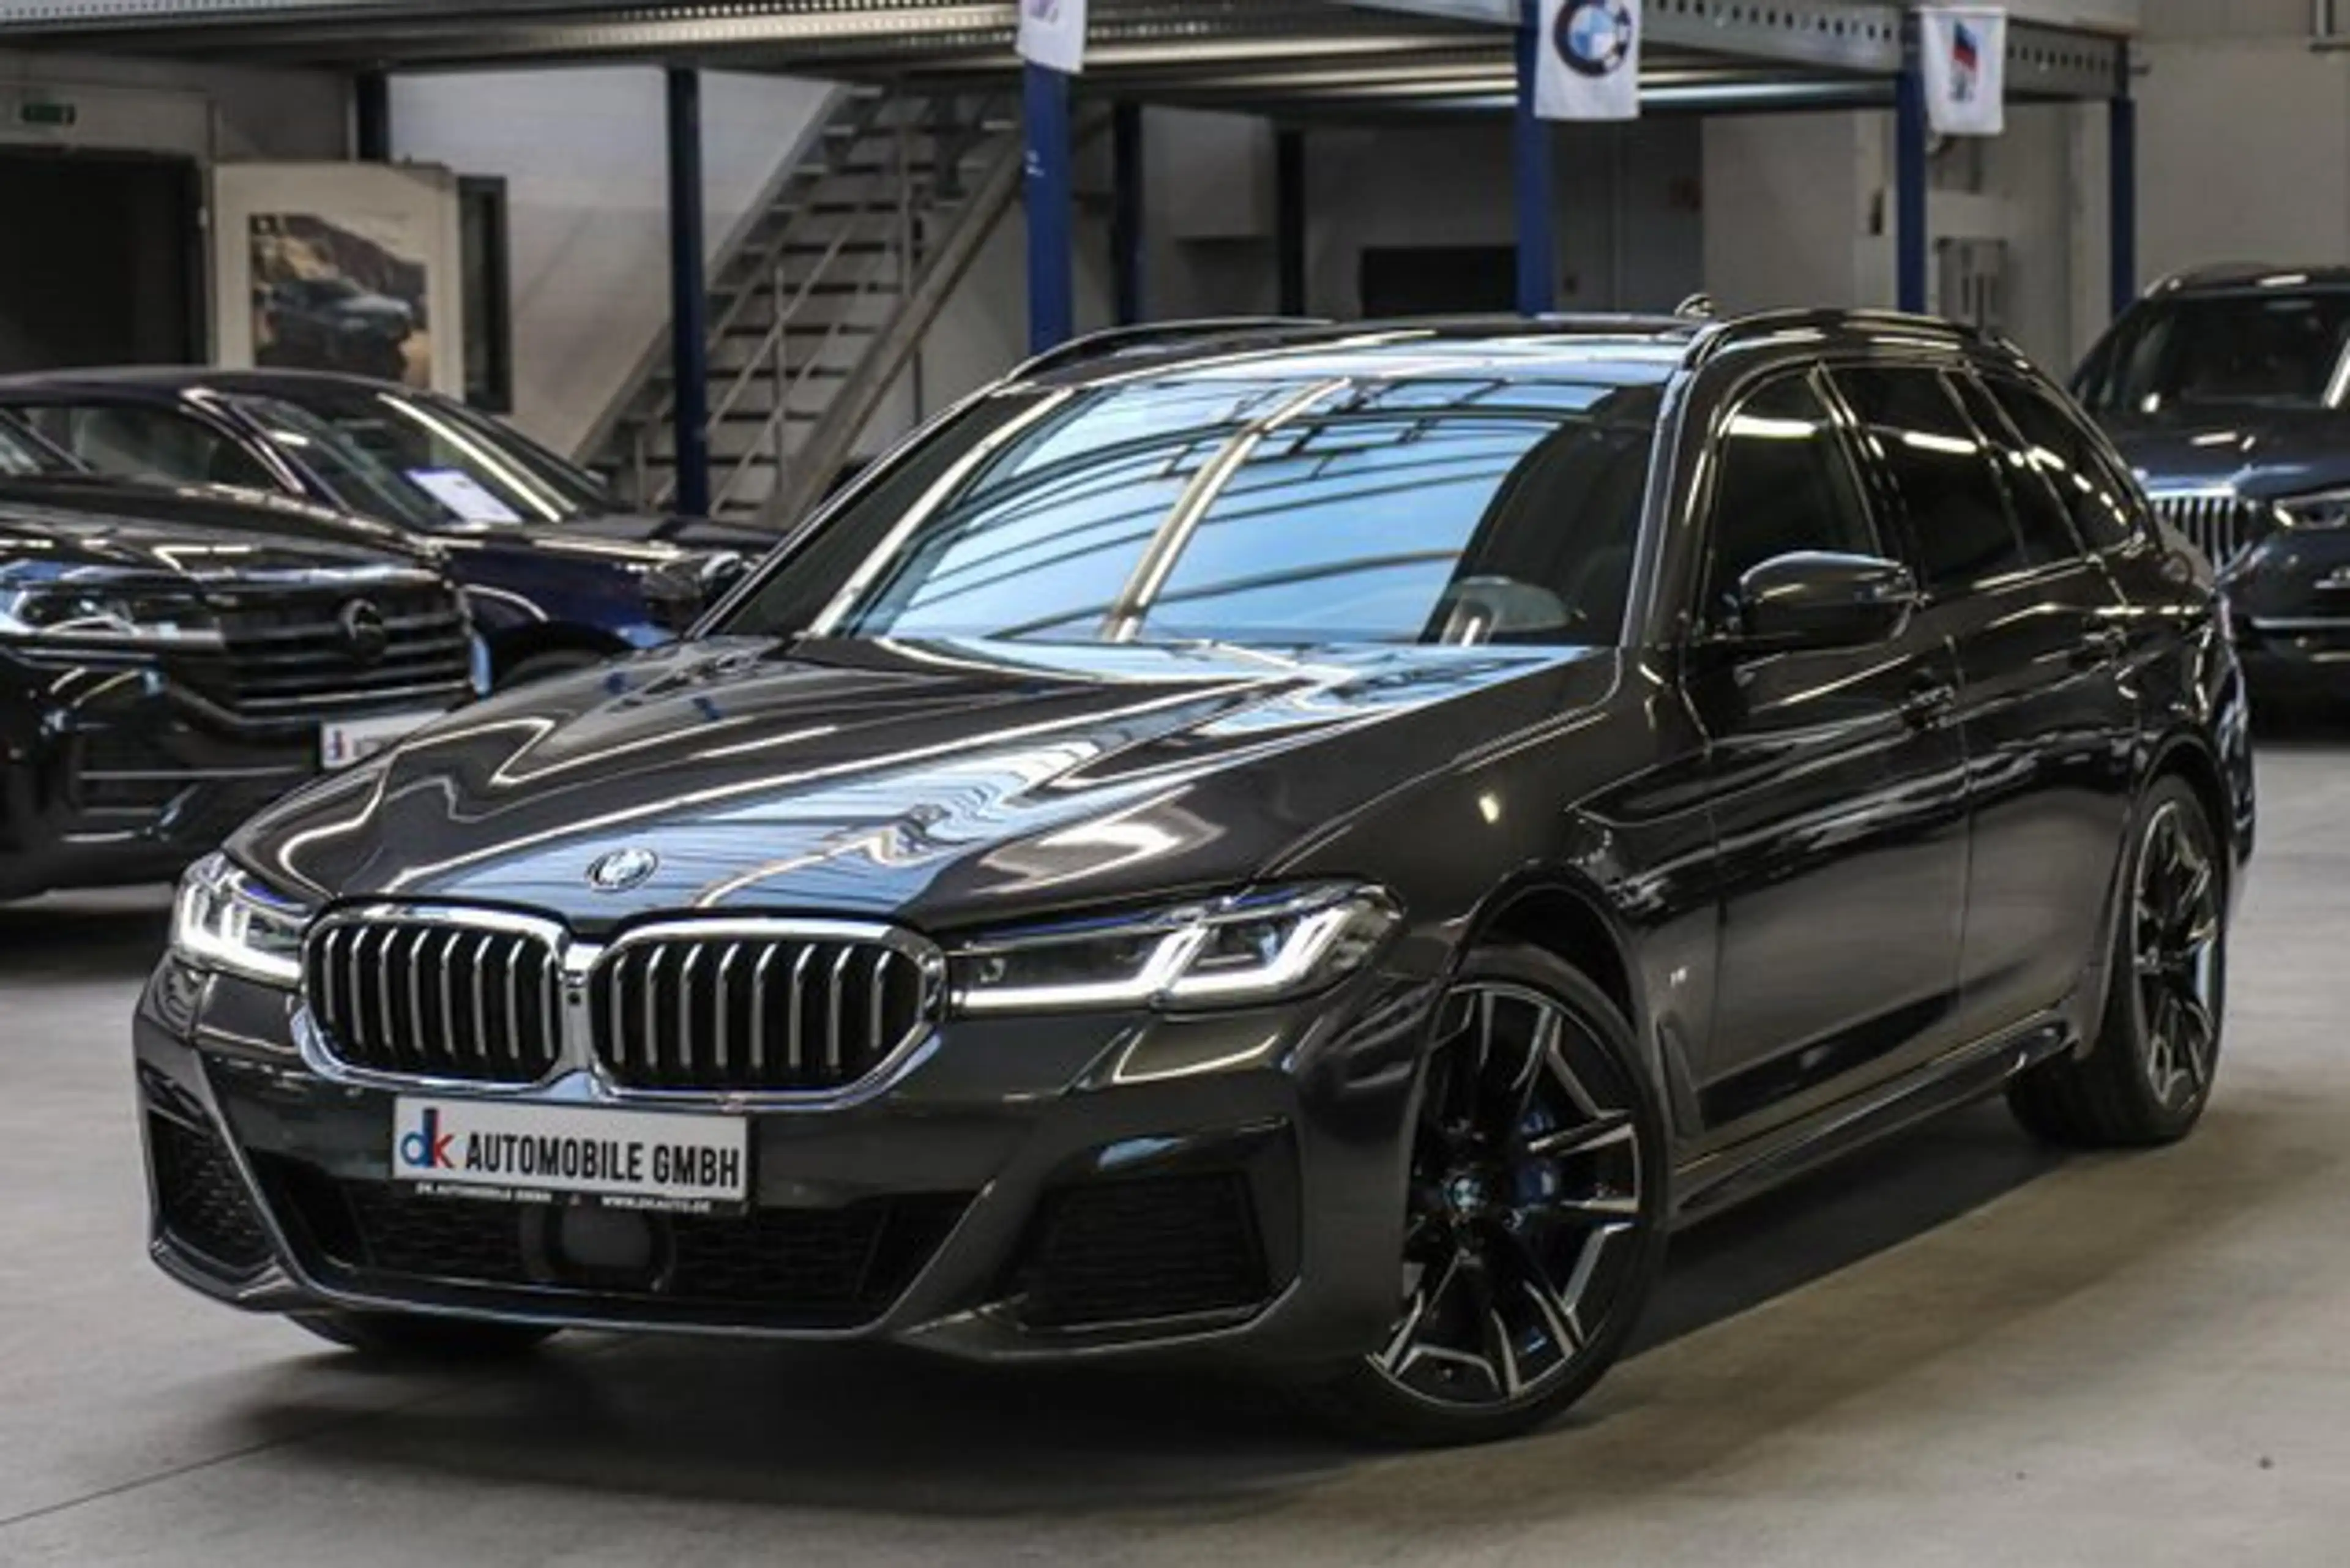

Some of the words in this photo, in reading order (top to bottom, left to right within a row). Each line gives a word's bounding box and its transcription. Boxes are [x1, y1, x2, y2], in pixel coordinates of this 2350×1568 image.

[400, 1107, 455, 1169] dk
[466, 1130, 644, 1182] AUTOMOBILE
[653, 1144, 739, 1190] GMBH
